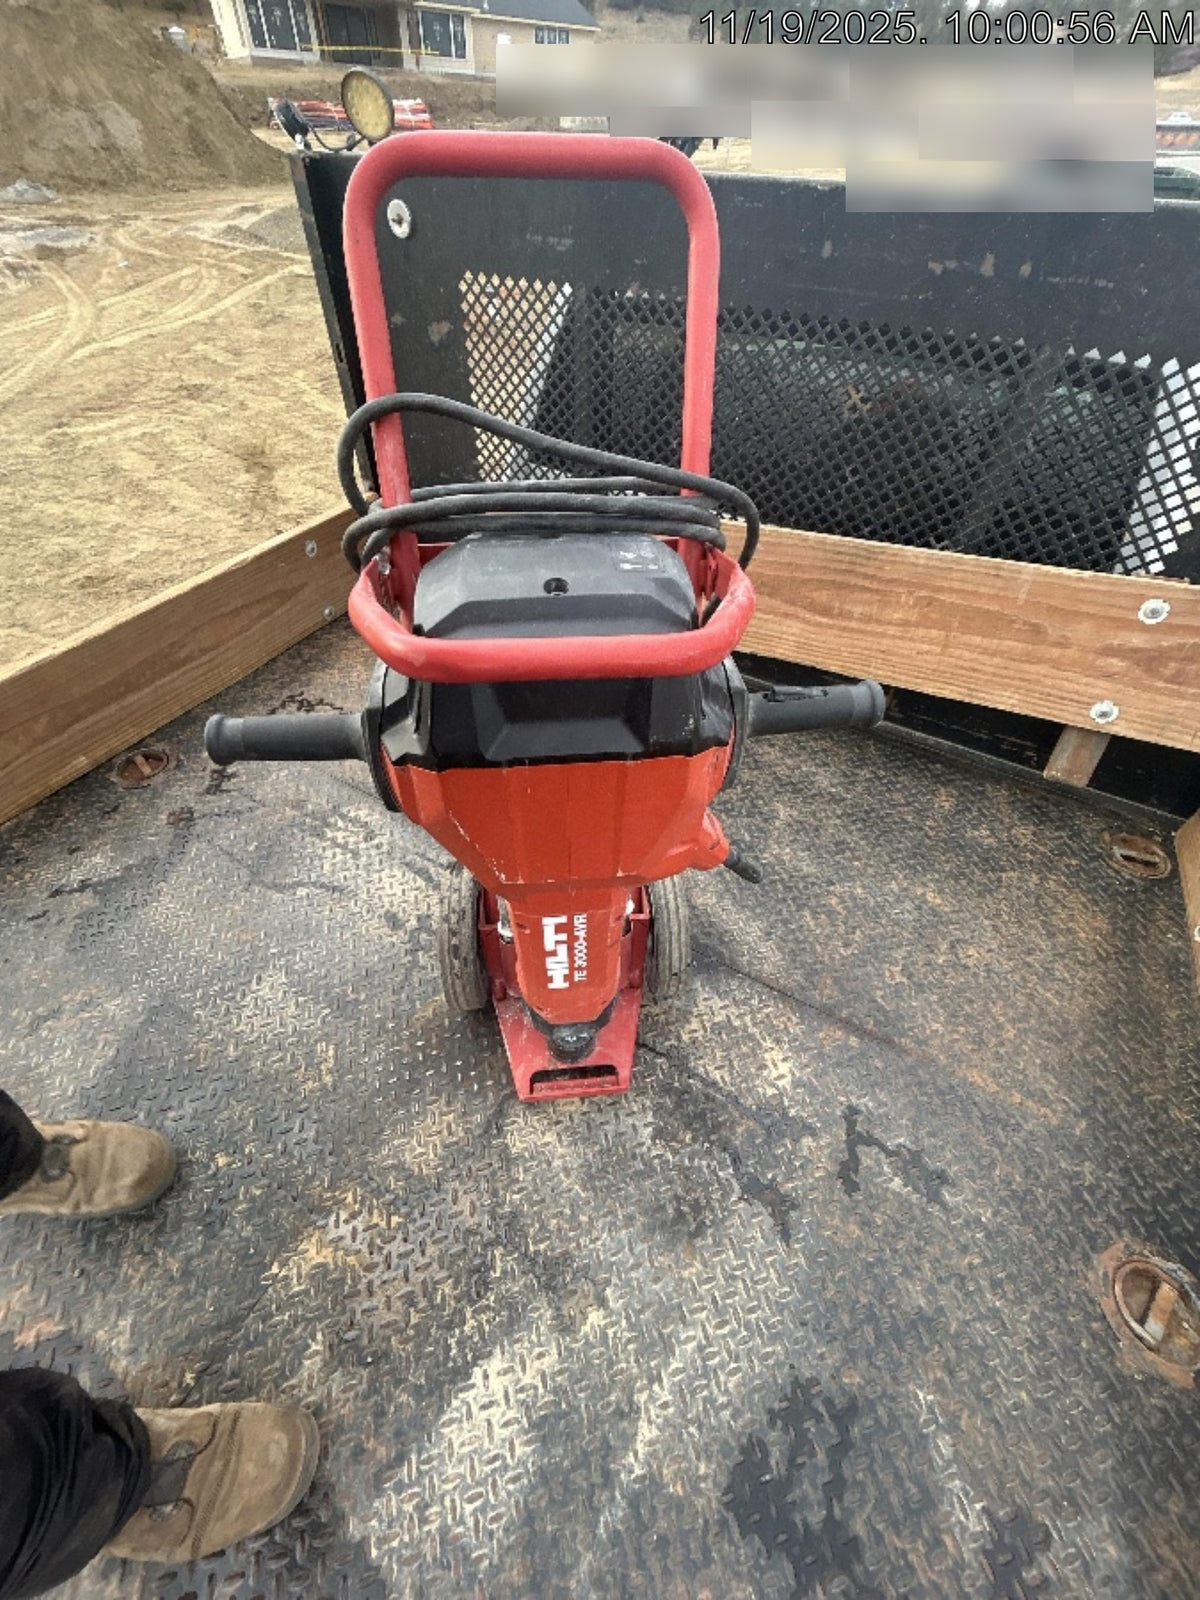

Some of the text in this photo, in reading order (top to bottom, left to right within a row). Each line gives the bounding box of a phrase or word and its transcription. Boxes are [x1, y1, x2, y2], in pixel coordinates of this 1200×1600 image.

[542, 915, 569, 989] HILTI
[574, 913, 587, 982] TE 3000-AVR
